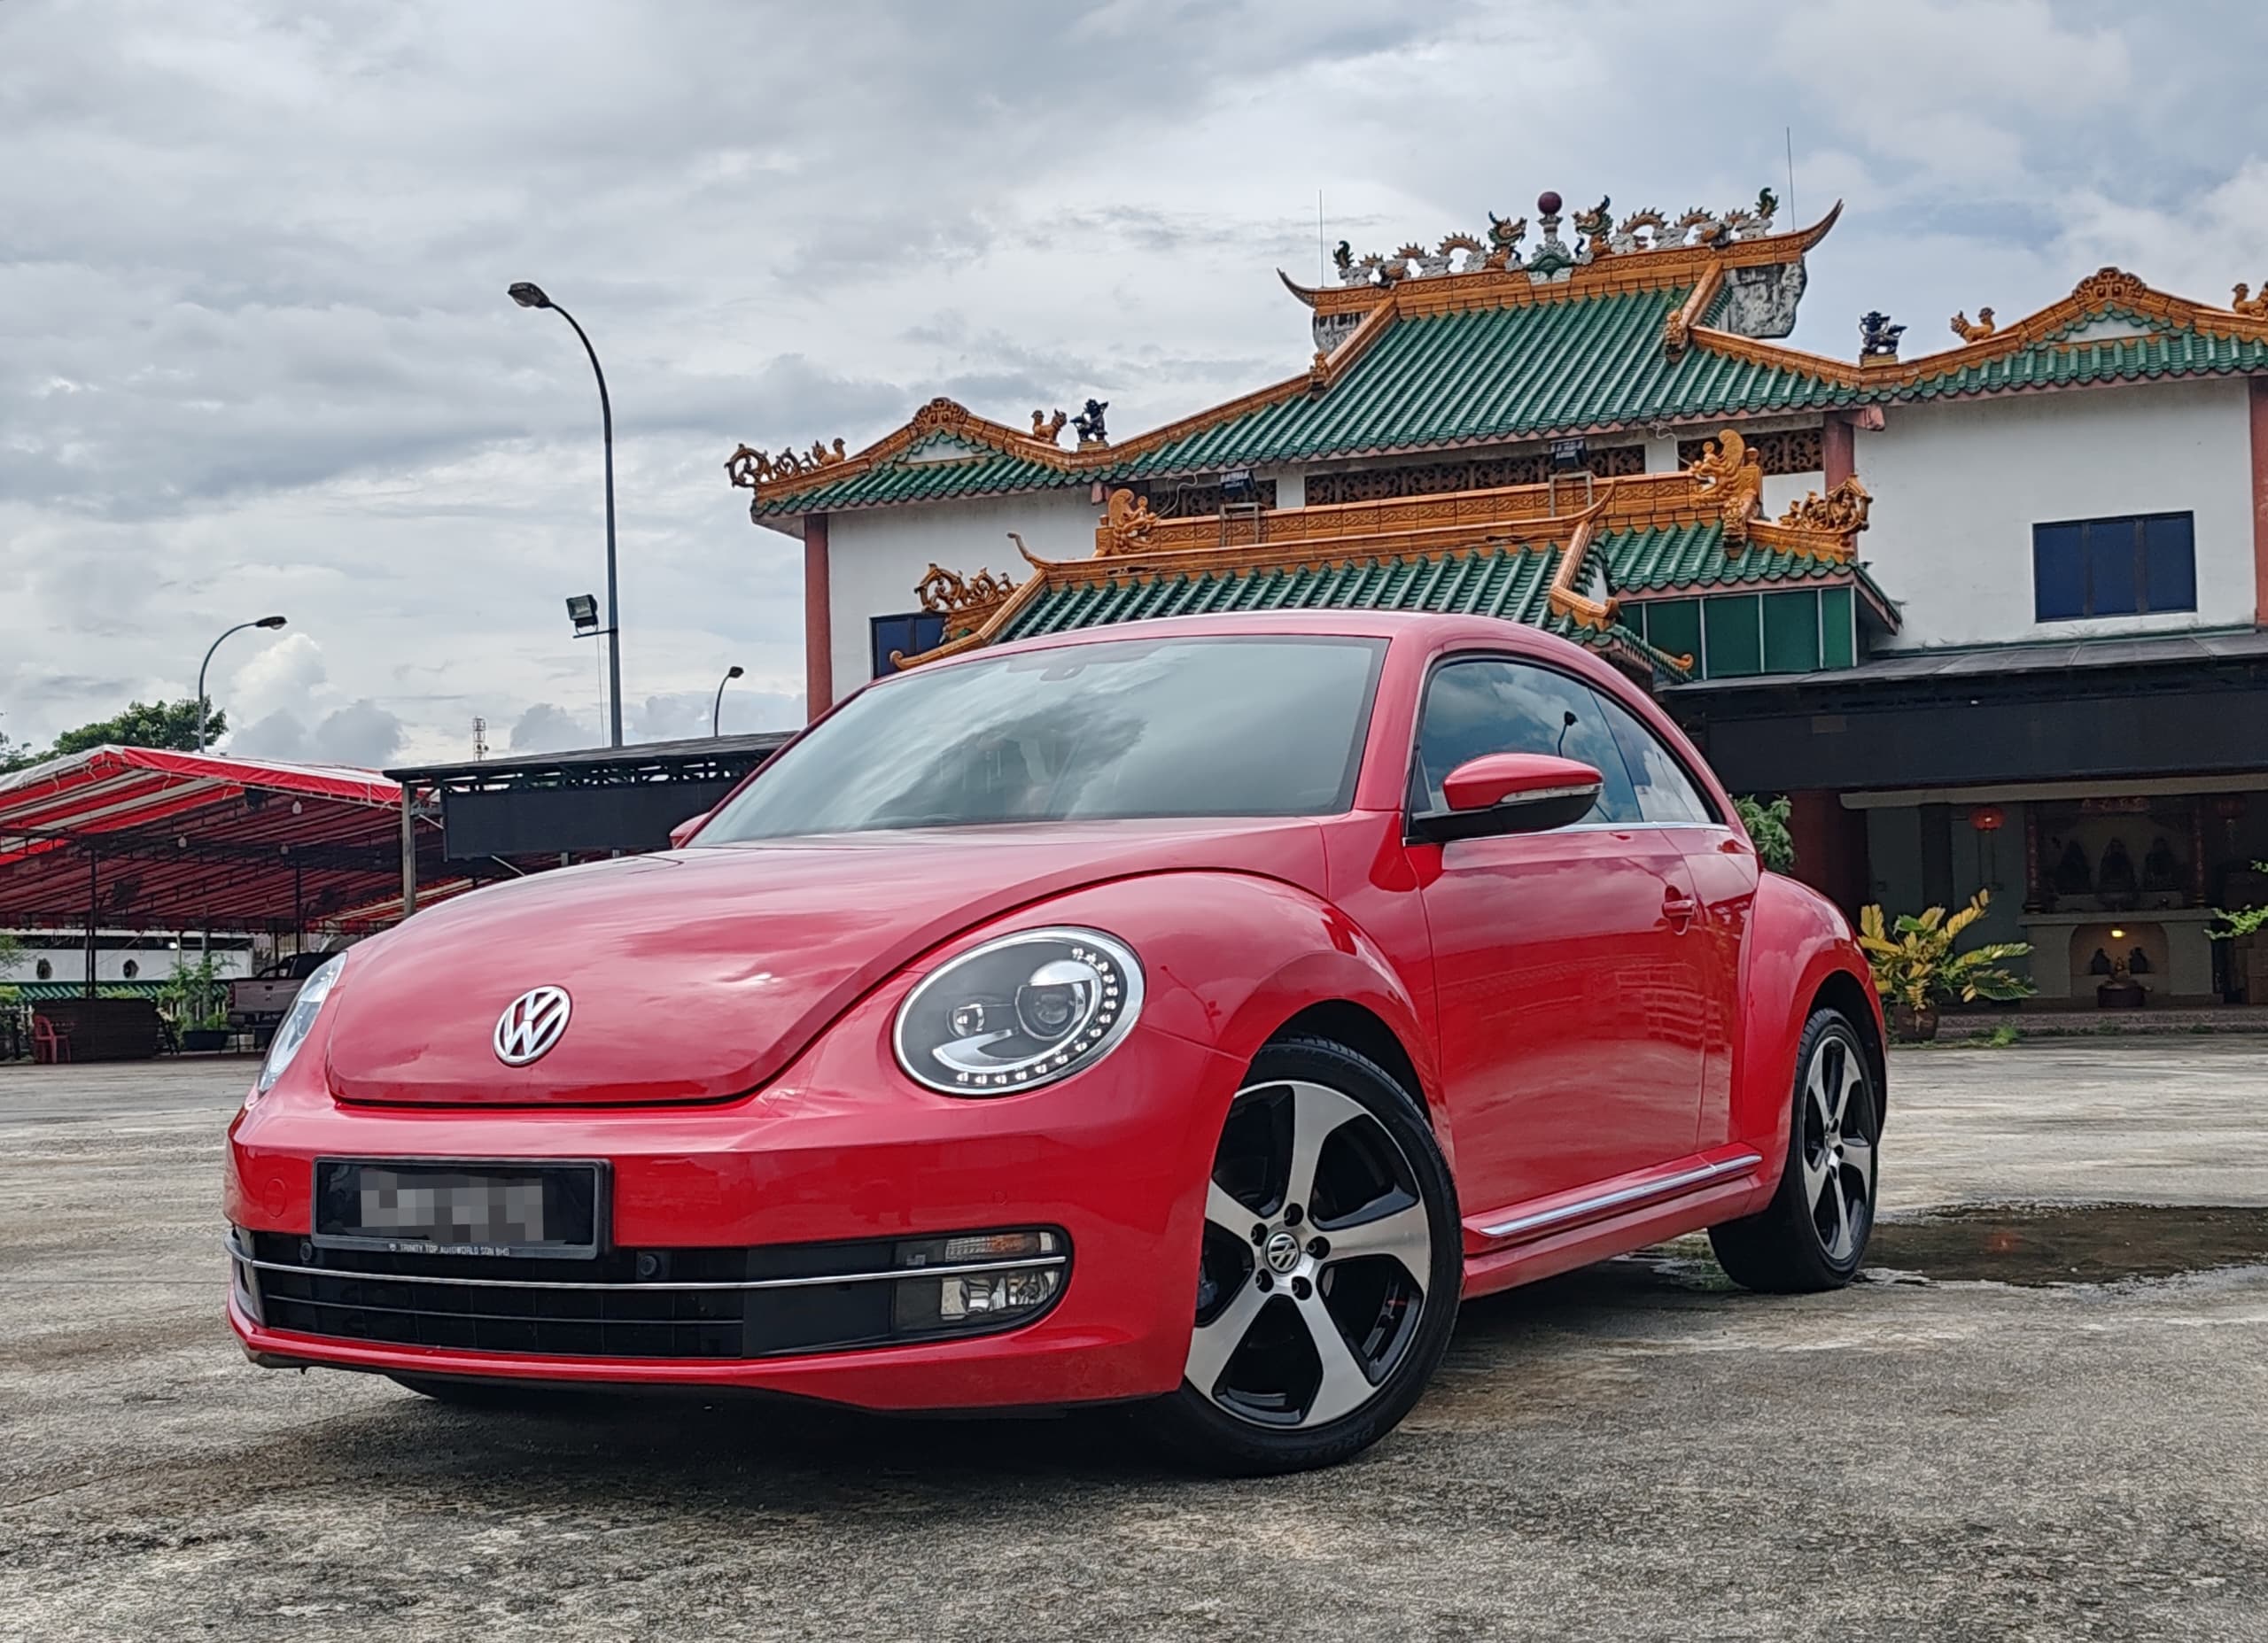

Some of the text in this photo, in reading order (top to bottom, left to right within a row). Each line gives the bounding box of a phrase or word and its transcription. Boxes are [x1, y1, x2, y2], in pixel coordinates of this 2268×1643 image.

[400, 1243, 423, 1253] TRINITY
[425, 1244, 438, 1254] TOP
[440, 1245, 478, 1255] AUTOWORLD
